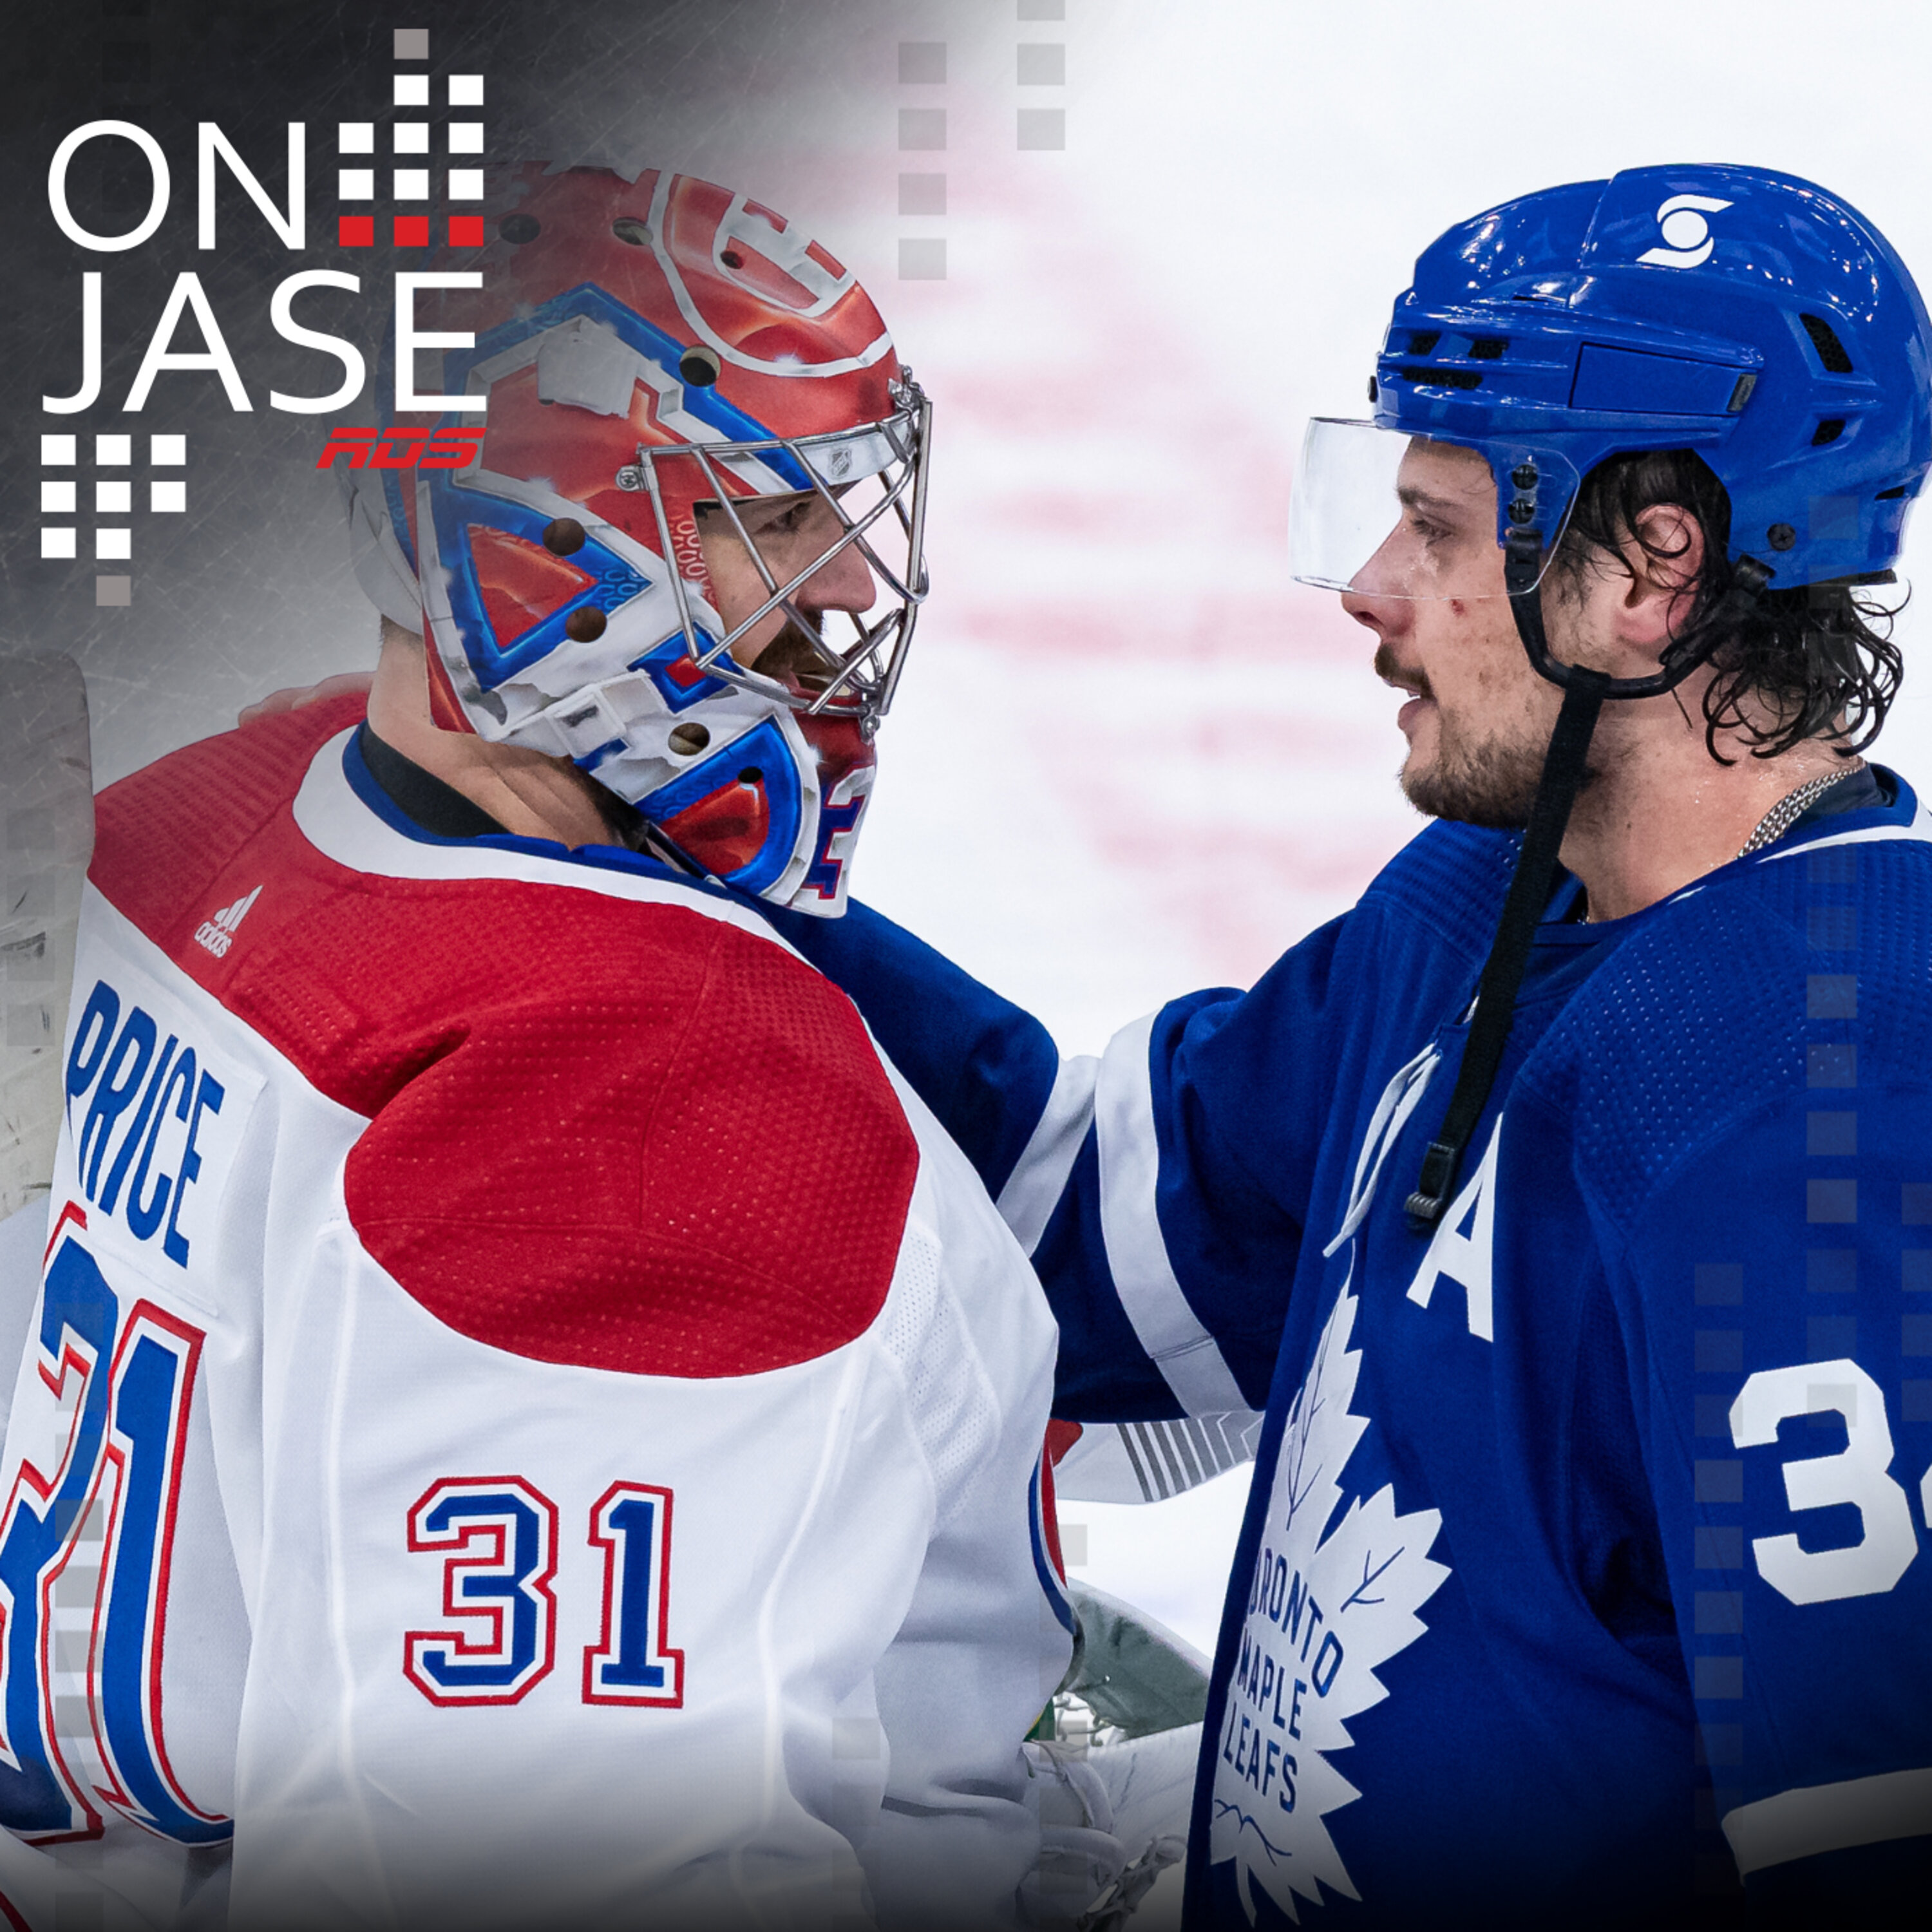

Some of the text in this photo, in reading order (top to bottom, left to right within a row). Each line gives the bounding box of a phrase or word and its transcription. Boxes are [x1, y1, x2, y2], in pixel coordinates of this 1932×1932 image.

[65, 979, 225, 1269] PRICE
[1405, 1111, 1504, 1343] A
[402, 1474, 685, 1709] 31
[1728, 1358, 1932, 1606] 3
[1223, 1700, 1298, 1814] LEAFS
[1237, 1627, 1308, 1741] MAPLE
